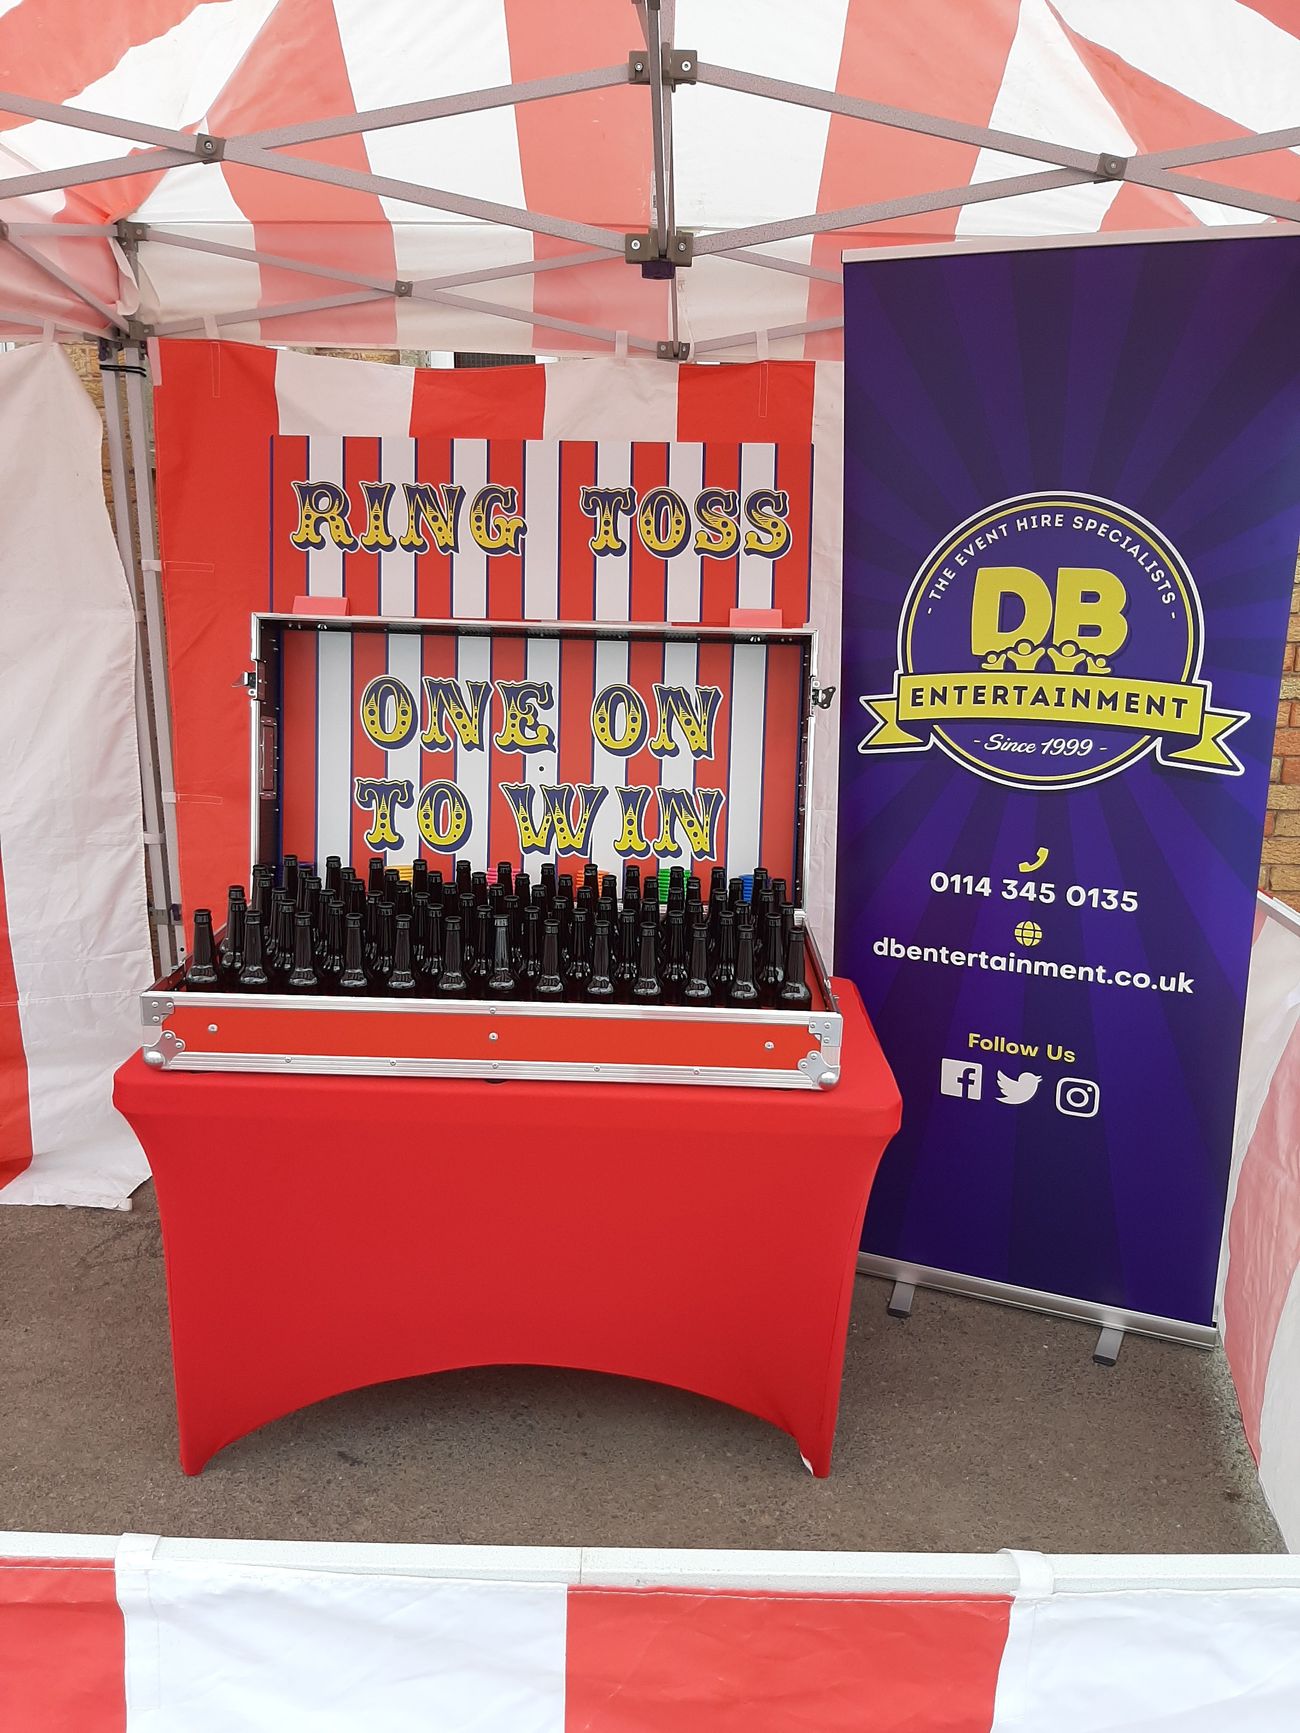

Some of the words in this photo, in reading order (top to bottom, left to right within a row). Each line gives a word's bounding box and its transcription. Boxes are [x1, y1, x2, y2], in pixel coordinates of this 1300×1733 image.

[291, 481, 528, 556] RING
[579, 486, 792, 560] TOSS
[930, 568, 956, 601] THE
[954, 523, 1009, 568] EVENT
[1016, 513, 1065, 532] HIRE
[1073, 516, 1176, 604] SPECIALISTS
[971, 567, 1128, 656] DB
[361, 676, 556, 753] ONE
[590, 684, 722, 759] ON
[911, 686, 1188, 719] ENTERTAINMENT
[983, 734, 1037, 754] Since
[1041, 738, 1093, 757] 1999
[356, 779, 472, 854] TO
[500, 784, 724, 861] WIN
[930, 871, 992, 897] 0114
[1001, 879, 1056, 905] 345
[1066, 885, 1139, 912] 0135
[872, 937, 1195, 994] dbentertainment.co.uk
[968, 1032, 1038, 1057] Follow
[1046, 1043, 1076, 1064] Us
